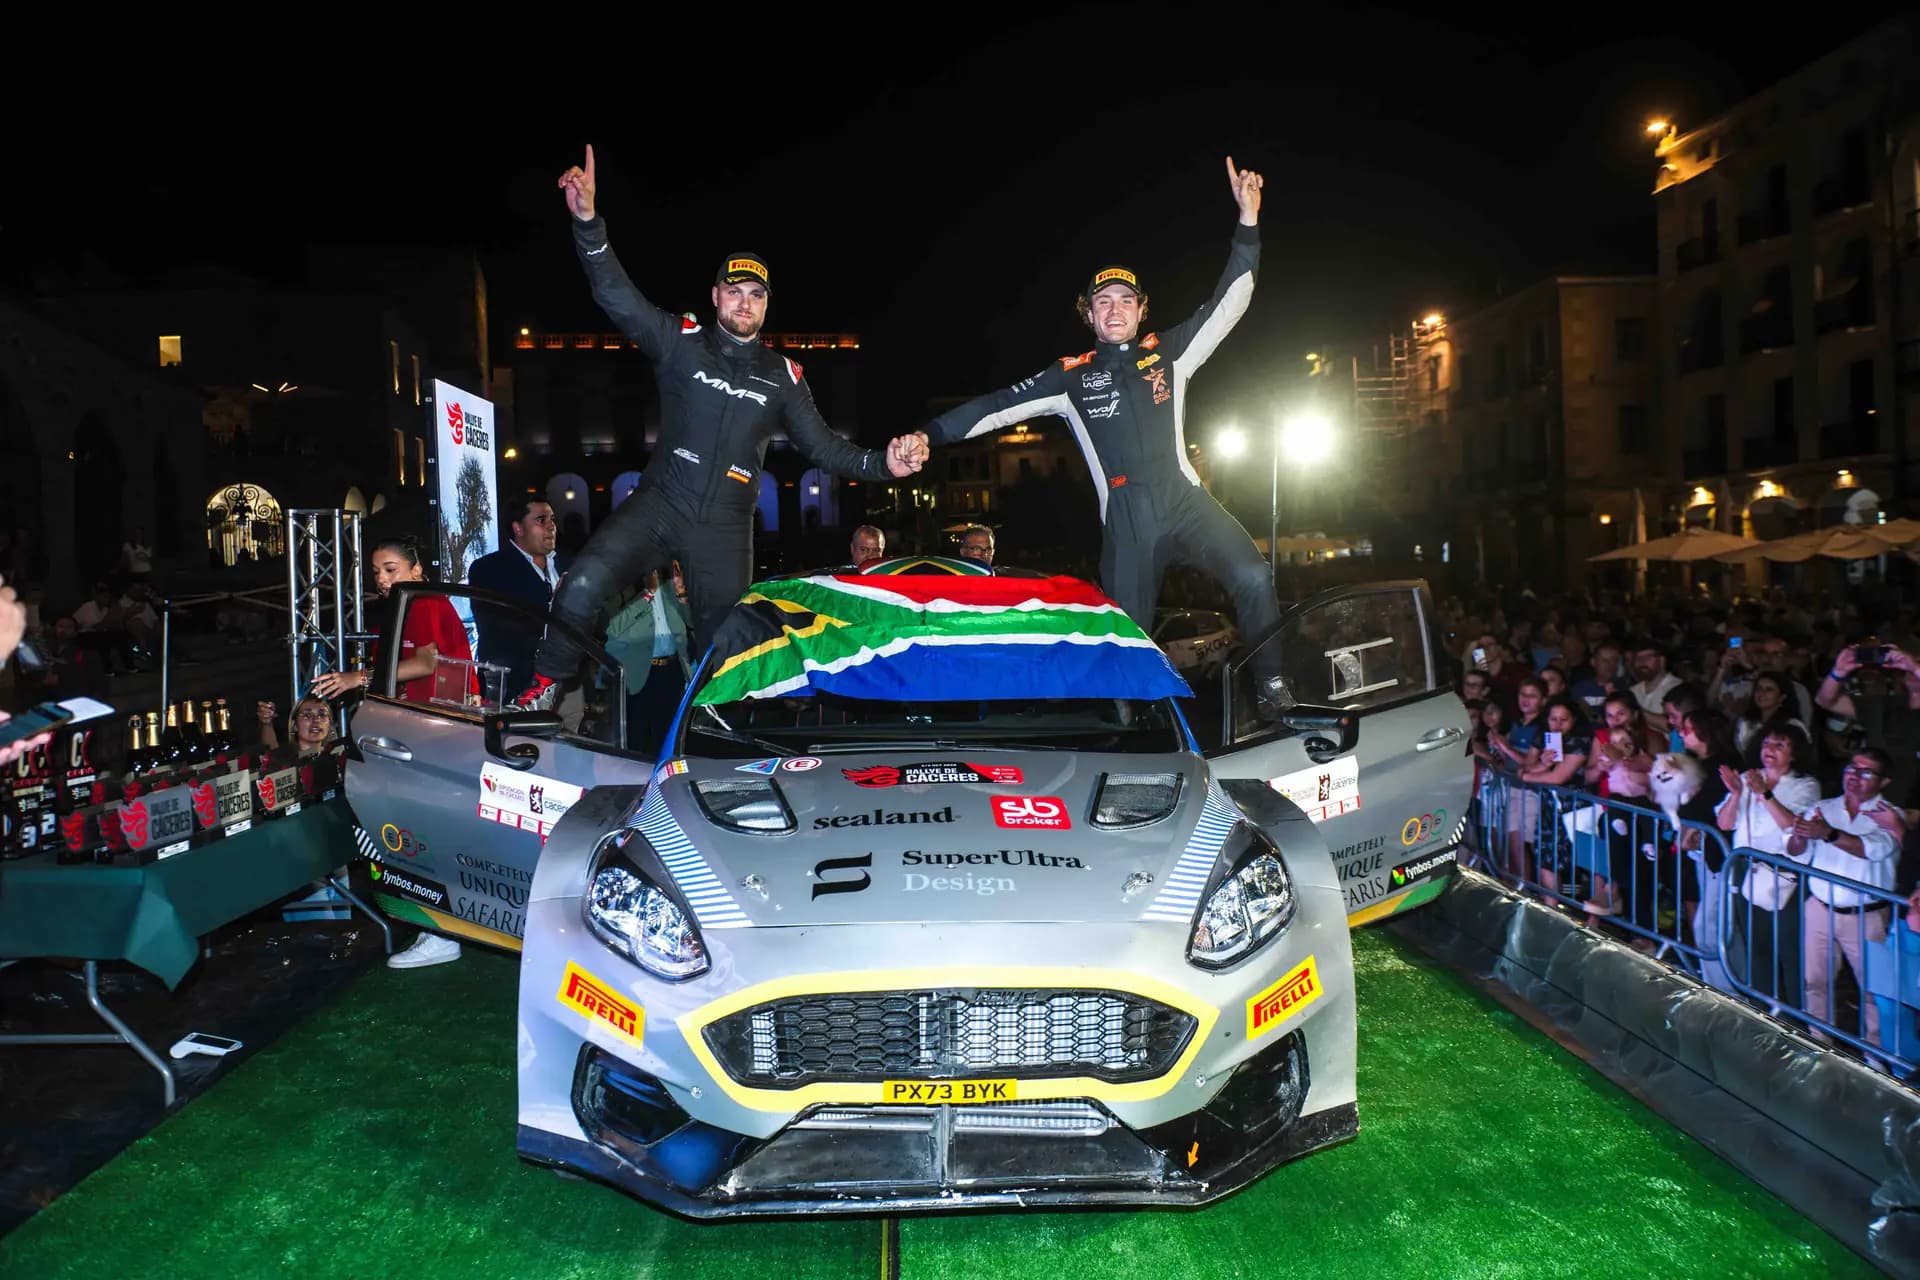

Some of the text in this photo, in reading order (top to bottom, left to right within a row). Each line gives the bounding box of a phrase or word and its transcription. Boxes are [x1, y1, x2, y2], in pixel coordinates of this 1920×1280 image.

[692, 371, 767, 406] MMR
[813, 807, 955, 829] sealand
[1000, 798, 1060, 817] sb
[1005, 816, 1061, 826] broker
[456, 854, 533, 884] COMPLETELY
[902, 849, 1085, 869] SuperUltra
[1338, 852, 1384, 881] IQUE
[1405, 850, 1457, 880] fynbos.money
[383, 869, 443, 905] fynbos.money
[460, 872, 530, 909] UNIQU
[903, 872, 1016, 896] Design
[566, 972, 636, 1036] PIRELLI
[1253, 968, 1313, 1029] PIRELLI
[894, 1083, 1007, 1099] PX73 BYK
